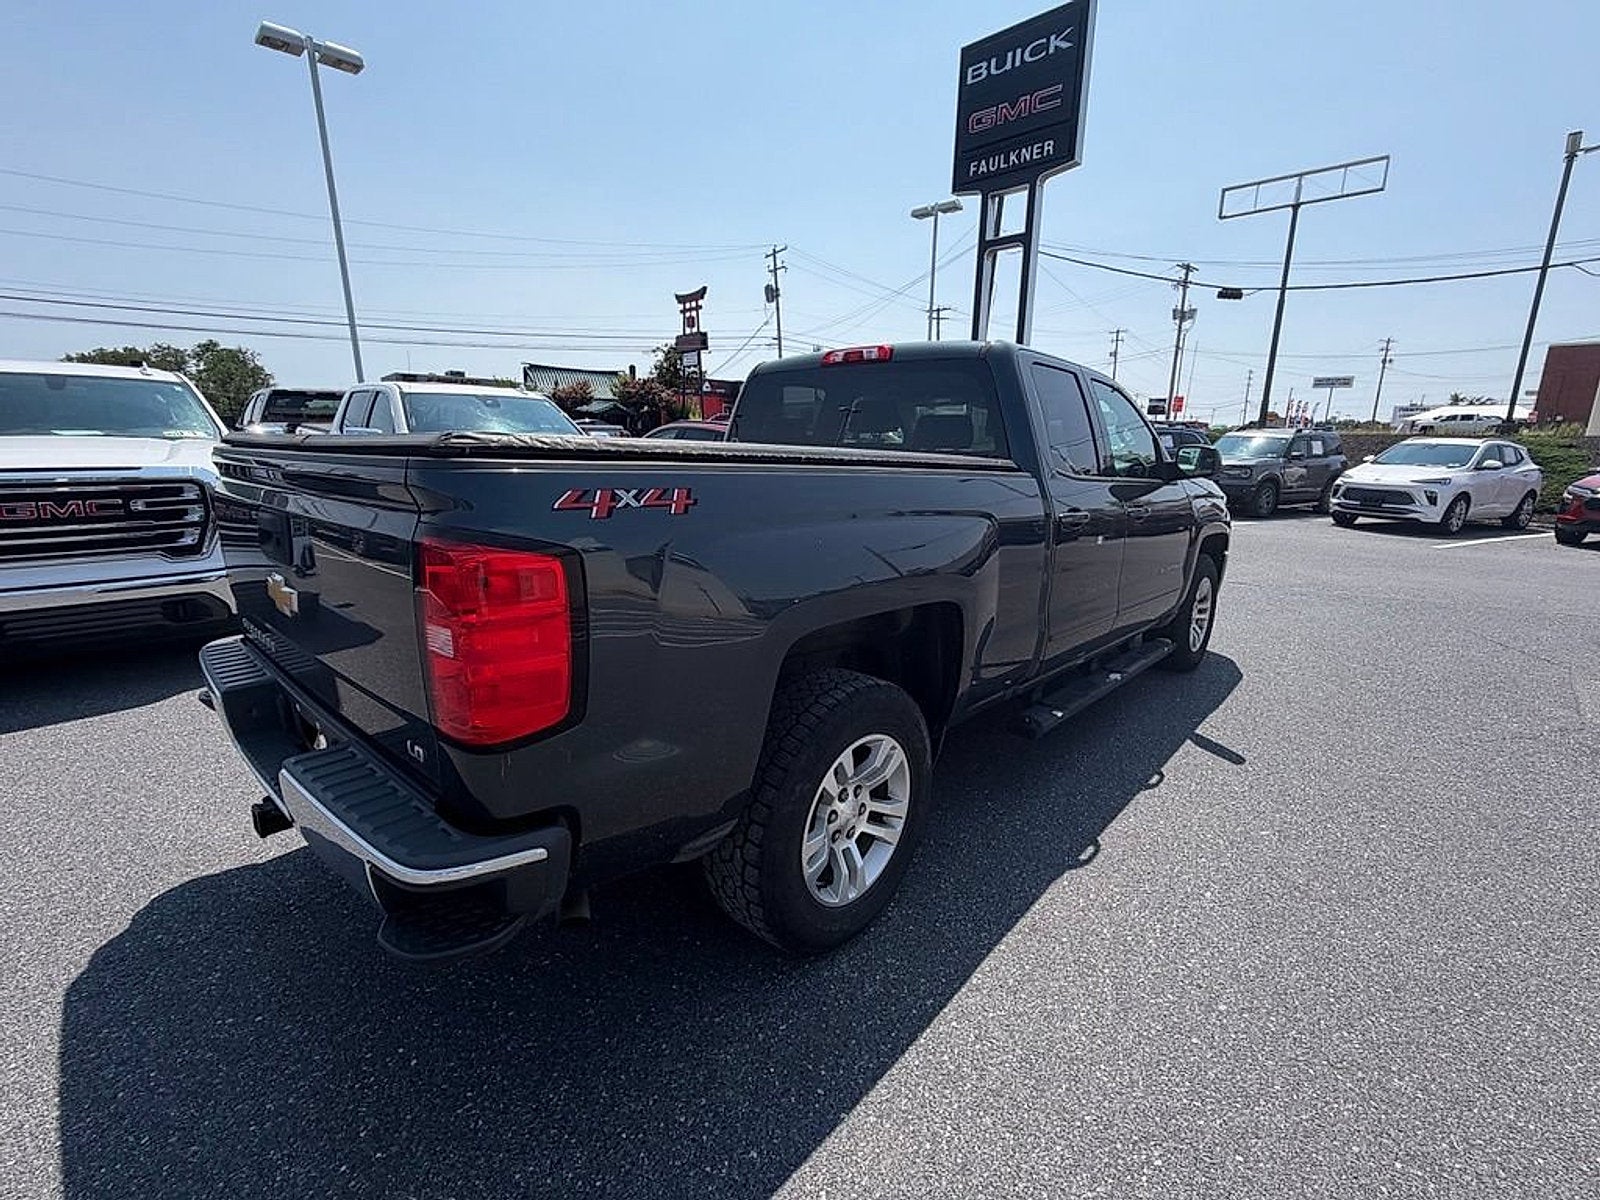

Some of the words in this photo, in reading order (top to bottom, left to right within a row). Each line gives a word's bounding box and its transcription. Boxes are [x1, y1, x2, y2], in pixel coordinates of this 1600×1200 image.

[966, 26, 1074, 85] BUICK
[968, 84, 1063, 134] GMC
[969, 139, 1055, 176] FAULKNER
[0, 498, 125, 520] GMC
